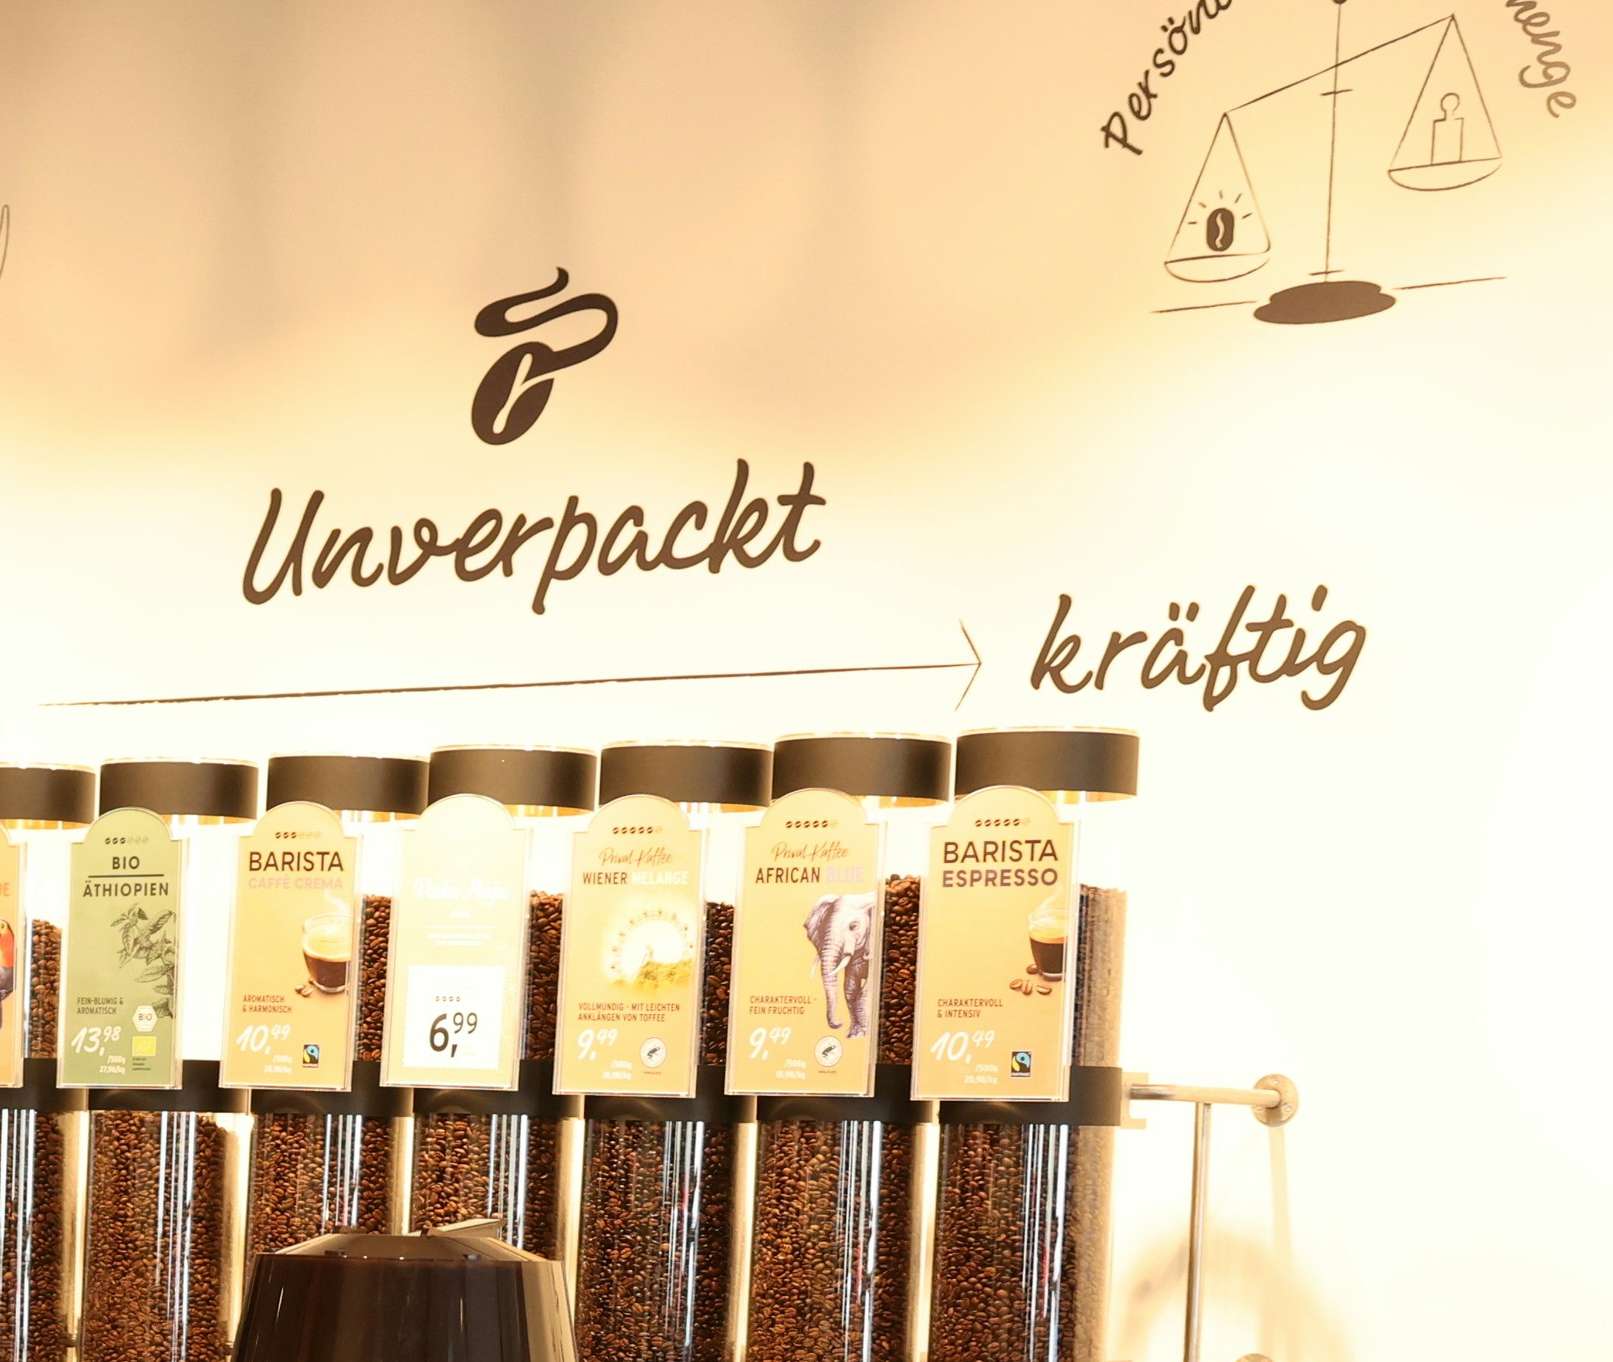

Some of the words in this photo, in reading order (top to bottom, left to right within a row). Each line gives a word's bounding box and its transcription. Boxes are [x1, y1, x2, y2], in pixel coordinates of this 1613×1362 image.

[1100, 0, 1233, 156] Persön
[242, 458, 827, 616] Unverpackt
[1030, 584, 1367, 712] kräftig
[943, 839, 1058, 864] BARISTA
[112, 856, 140, 870] BIO
[248, 851, 344, 872] BARISTA
[248, 874, 290, 890] CAFFÈ
[294, 877, 343, 890] CREMA
[582, 872, 627, 885] WIENER
[631, 871, 689, 885] MELANGE
[755, 867, 820, 884] AFRICAN
[825, 866, 864, 883] BLUE
[942, 868, 1058, 887] ESPRESSO
[82, 880, 169, 897] ÄTHIOPIEN
[243, 995, 284, 1004] AROMATISCH
[579, 1003, 624, 1012] VOLLMUNDIG
[631, 1003, 644, 1012] MIT
[645, 1003, 680, 1012] LEICHTEN
[750, 996, 812, 1005] CHARAKTERVOLL
[937, 998, 1003, 1008] CHARAKTERVOLL
[248, 1005, 292, 1014] HARMONISCH
[578, 1012, 620, 1022] ANKLÄNGEN
[622, 1013, 637, 1022] VON
[639, 1013, 665, 1022] TOFFEE
[749, 1006, 765, 1015] FEIN
[767, 1006, 805, 1015] FRUCHTIG
[944, 1010, 981, 1018] INTENSIV
[71, 1025, 121, 1056] 13,98
[236, 1023, 291, 1055] 10,49
[429, 1011, 478, 1058] 6,99
[748, 1027, 791, 1060] 9,49
[577, 1028, 618, 1060] 9,49
[930, 1031, 996, 1063] 10,49
